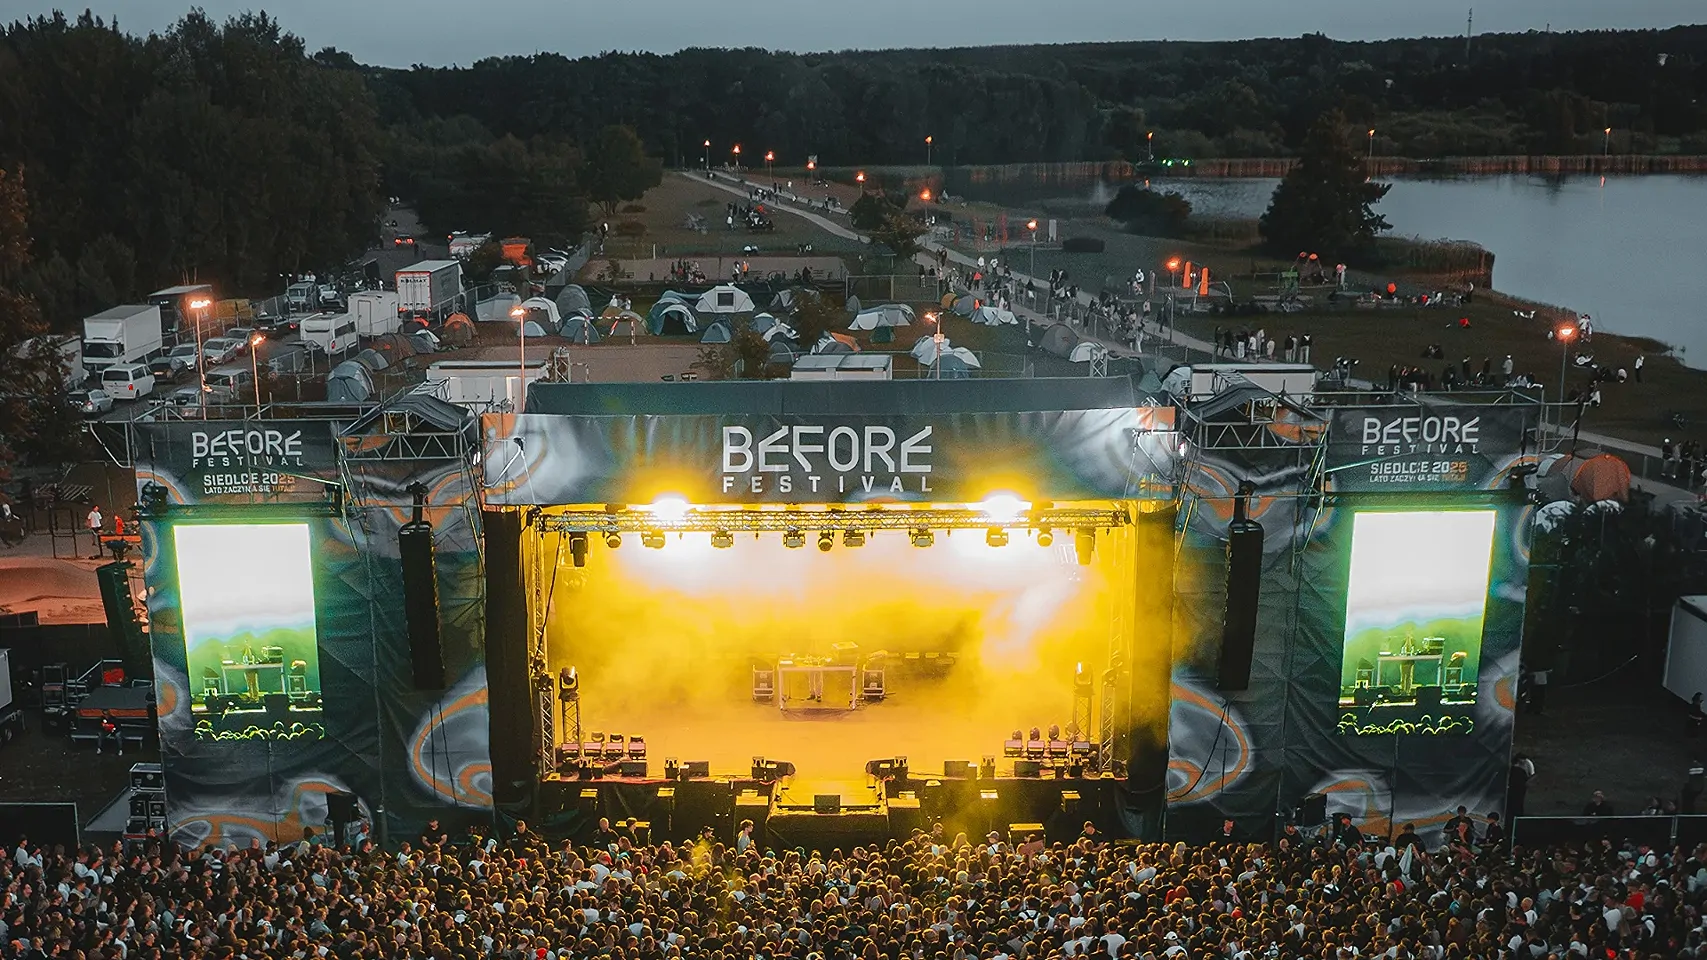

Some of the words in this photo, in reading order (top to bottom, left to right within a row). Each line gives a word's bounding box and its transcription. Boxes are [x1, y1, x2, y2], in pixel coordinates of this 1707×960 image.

[1362, 416, 1480, 444] BEFORE
[191, 429, 303, 458] BEFORE
[722, 425, 933, 473] BEFORE
[1361, 443, 1481, 456] FESTIVAL
[192, 456, 303, 469] FESTIVAL
[1370, 461, 1429, 475] SIEDLCE
[203, 472, 259, 486] SIEDLCE
[262, 472, 296, 485] 2025
[722, 475, 933, 493] FESTIVAL
[1369, 475, 1388, 483] LATO
[204, 486, 223, 494] LATO
